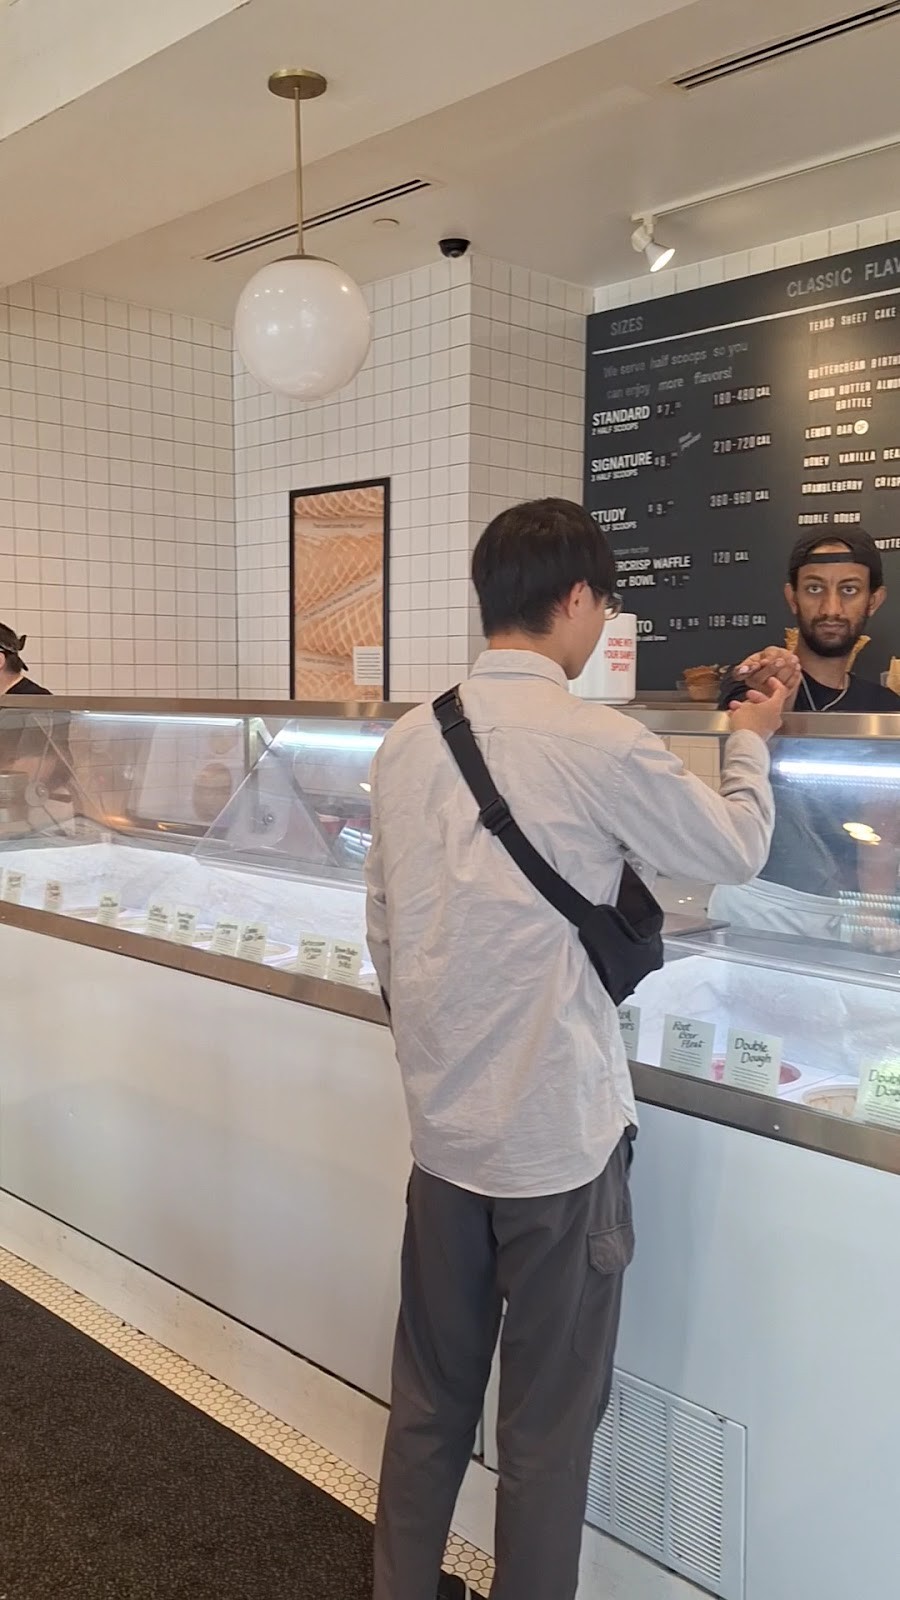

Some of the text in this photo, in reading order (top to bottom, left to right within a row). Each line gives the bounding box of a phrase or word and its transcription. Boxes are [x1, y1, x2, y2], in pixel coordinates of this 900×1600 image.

[787, 267, 852, 297] CLASSIC
[610, 316, 644, 336] SIZES
[808, 307, 896, 331] TEXAS SHEET CAKE
[603, 342, 749, 378] We serve half scoops so you
[808, 359, 866, 379] BUTTERCREAM
[607, 366, 733, 400] can enjoy more flavors!
[756, 386, 771, 397] CAL
[808, 387, 835, 401] BROWN
[839, 381, 871, 395] BUTTER
[836, 397, 873, 411] BRITTLE
[592, 405, 651, 426] STANDARD
[597, 426, 612, 435] HALF
[613, 422, 639, 433] SCOOPS
[805, 426, 831, 439] LEMON
[837, 424, 853, 436] BAR
[713, 436, 756, 453] 210-720
[756, 435, 771, 446] CAL
[591, 451, 653, 473] SIGNATURE
[804, 456, 830, 468] HONEY
[839, 450, 876, 464] VANILLA
[596, 472, 612, 481] HALF
[613, 468, 639, 479] SCOOPS
[802, 480, 863, 494] BRAMBLEBERRY
[710, 489, 770, 507] 360-960 CAL
[590, 508, 627, 523] STUDY
[798, 512, 860, 525] DOUBLE DOUGH
[611, 521, 638, 531] SCOOPS
[653, 556, 691, 569] WAFFLE
[713, 551, 749, 563] 120 CAL
[616, 579, 628, 587] or
[629, 574, 656, 587] BOWL
[636, 620, 654, 634] TO
[752, 615, 767, 625] CAL
[608, 637, 623, 647] DONE
[604, 650, 619, 659] YOUR
[672, 1021, 692, 1032] Root
[679, 1031, 699, 1039] Beer
[681, 1040, 706, 1048] Float
[734, 1037, 769, 1053] Double
[740, 1051, 772, 1068] Dough
